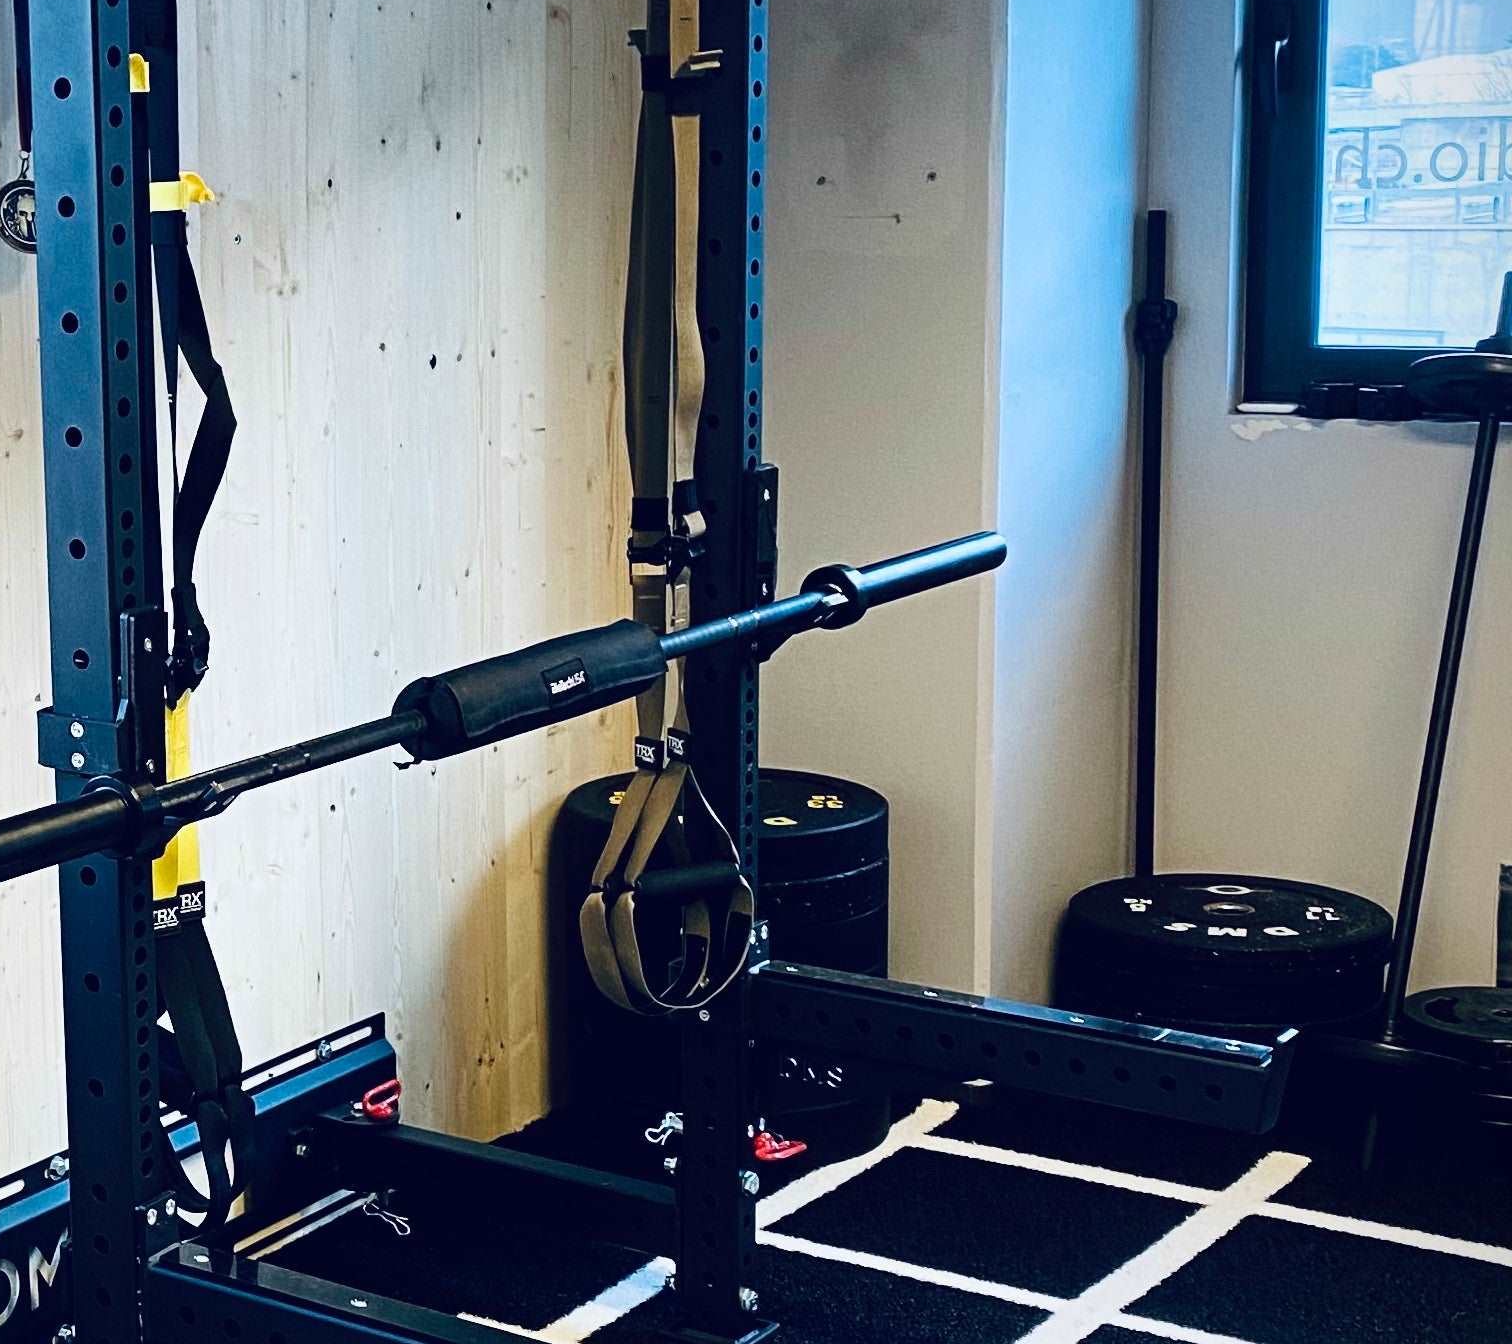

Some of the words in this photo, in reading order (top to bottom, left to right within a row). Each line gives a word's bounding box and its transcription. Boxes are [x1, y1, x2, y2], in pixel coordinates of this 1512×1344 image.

[635, 744, 655, 760] TRX
[667, 736, 685, 754] TRX
[179, 891, 203, 909] RX
